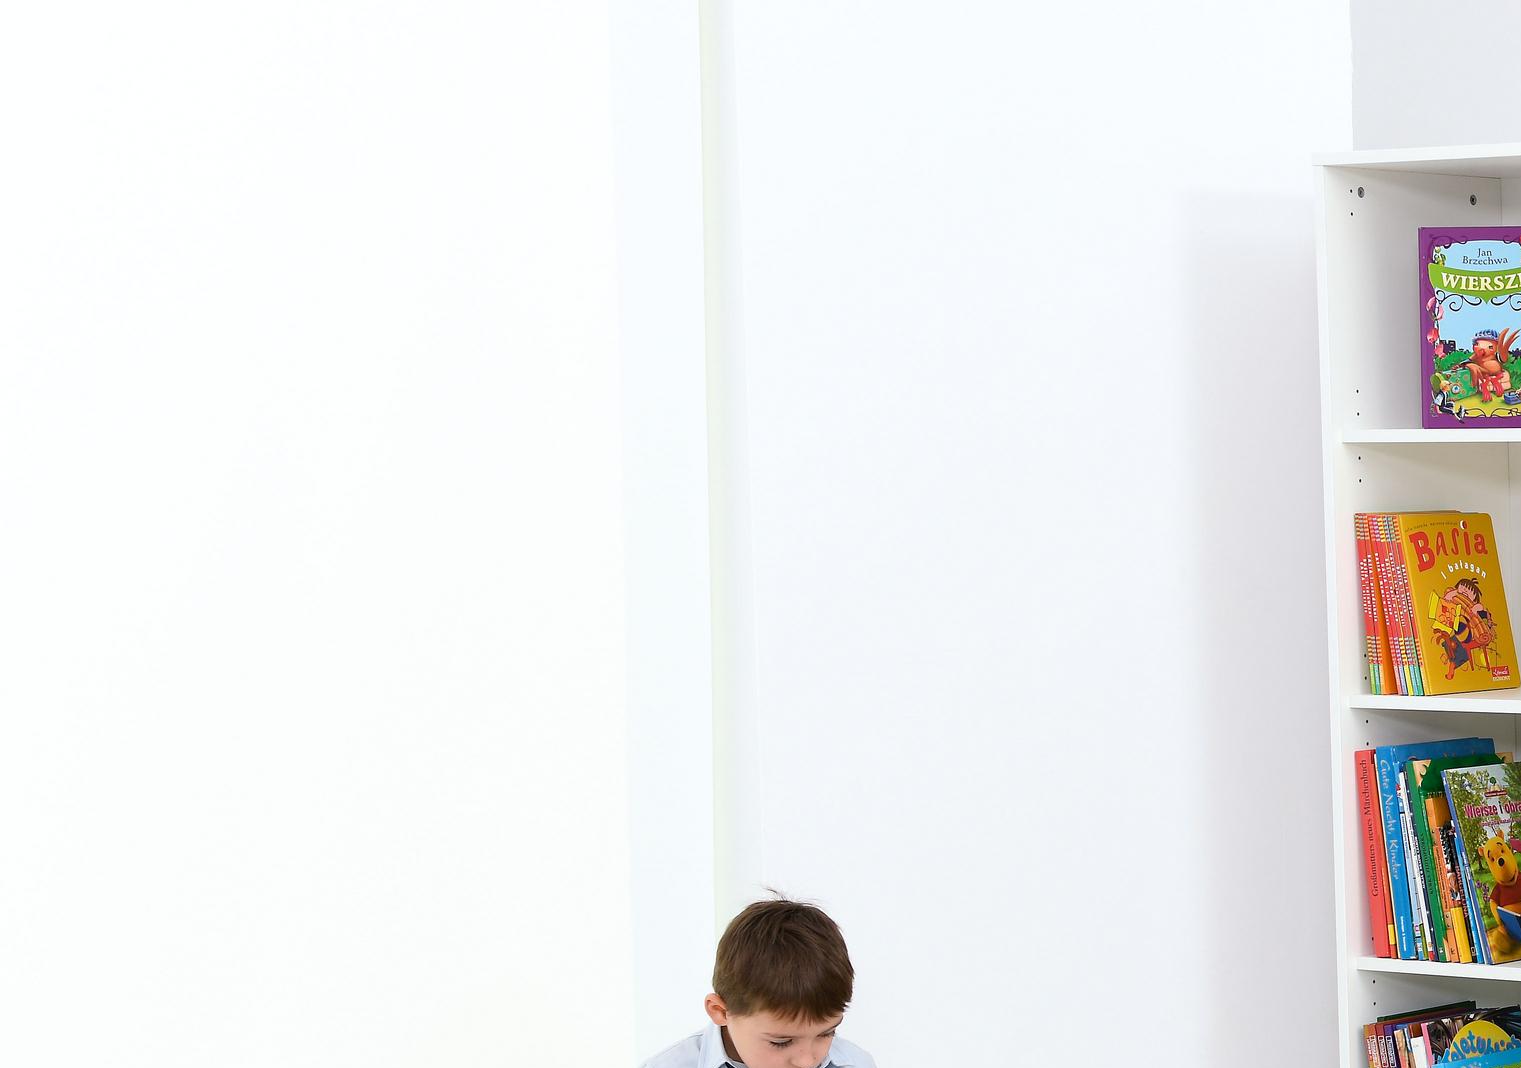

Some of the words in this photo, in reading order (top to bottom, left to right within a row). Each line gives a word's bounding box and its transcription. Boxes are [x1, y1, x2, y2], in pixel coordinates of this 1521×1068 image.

[1463, 256, 1509, 266] Brzechwa
[1478, 248, 1493, 258] Jan
[1448, 560, 1487, 579] bałagan
[1465, 803, 1499, 819] Wiersze
[1380, 760, 1392, 790] Gute
[1390, 840, 1400, 880] Kinder
[1365, 818, 1374, 841] neues
